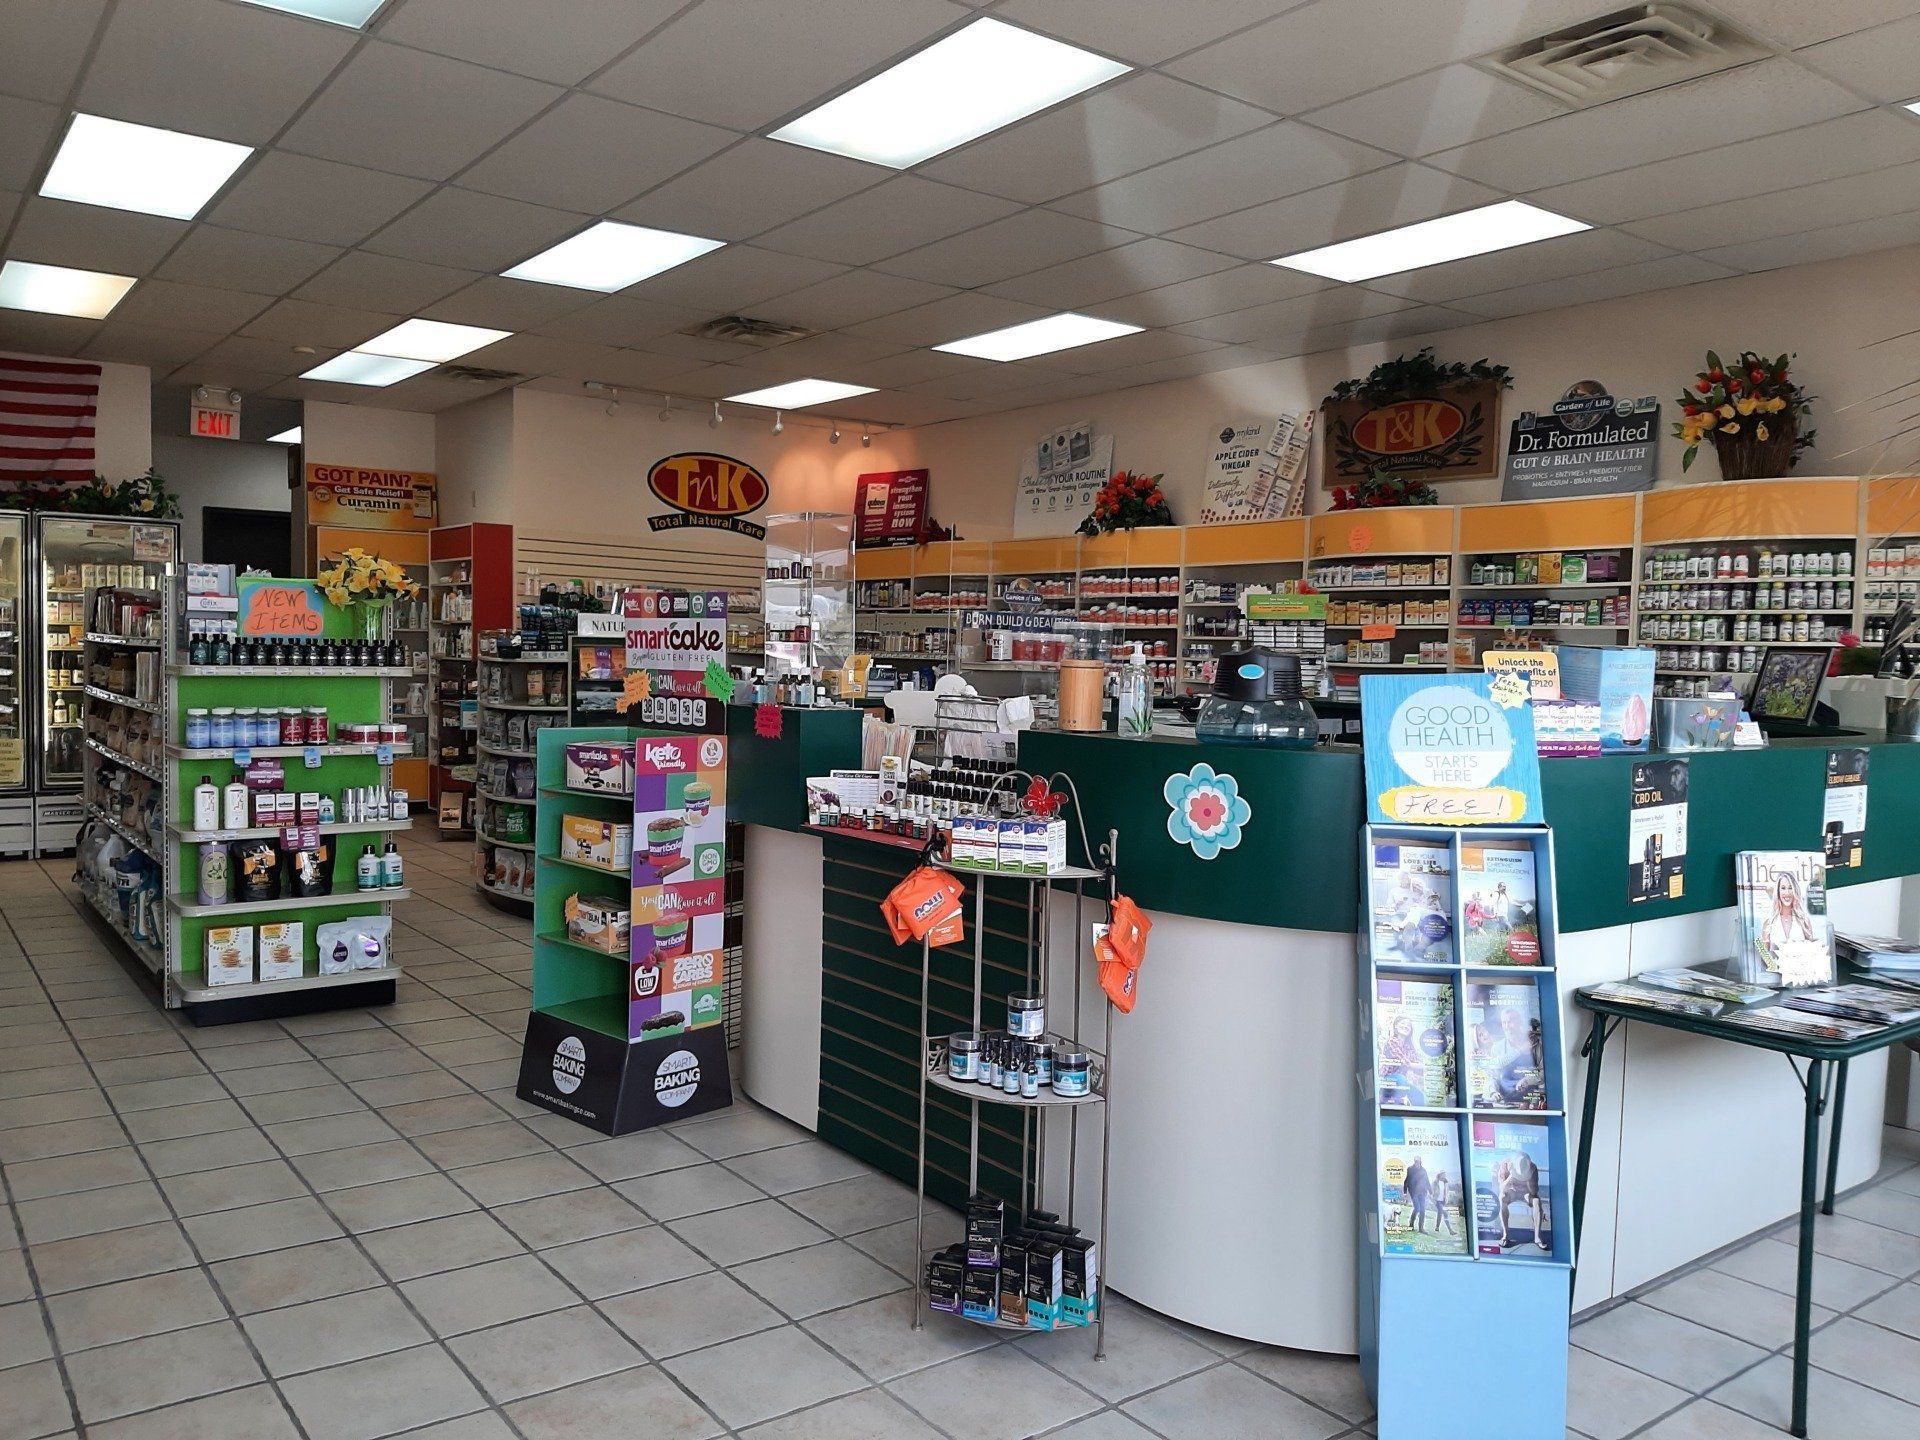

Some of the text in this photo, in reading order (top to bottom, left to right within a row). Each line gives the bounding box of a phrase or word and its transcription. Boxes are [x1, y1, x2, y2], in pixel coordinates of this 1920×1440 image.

[1555, 403, 1584, 412] Garden
[1595, 398, 1611, 407] Life
[197, 410, 234, 436] EXIT
[1367, 402, 1446, 451] T&K
[1517, 421, 1649, 452] Dr. Formulated
[1215, 449, 1260, 461] APPLE CIDER
[1513, 448, 1646, 469] GUT & BRAIN HEALTH
[1221, 460, 1251, 470] VINEGAR
[314, 467, 412, 488] GOT PAIN?
[1054, 469, 1106, 483] YOUR ROUTINE
[1512, 472, 1549, 481] PROBIOTICS
[1555, 469, 1584, 478] ENZYMES
[1532, 475, 1618, 487] MAGNESIUM BRAIN HEALTH
[334, 485, 351, 494] Get
[353, 487, 373, 496] Safe
[337, 495, 401, 510] Curamin
[653, 515, 764, 538] Total Natural Kare
[254, 588, 305, 608] NEW
[996, 616, 1023, 627] BUILD
[626, 621, 724, 652] smartcake
[650, 653, 684, 662] GLUTEN
[688, 654, 711, 662] FREE
[1498, 658, 1543, 667] Unlock the
[1548, 667, 1557, 676] of
[1405, 705, 1490, 726] GOOD
[1404, 726, 1494, 746] HEALTH
[645, 742, 682, 763] keto
[1425, 755, 1478, 768] STARTS
[1433, 769, 1472, 782] HERE
[1635, 791, 1663, 805] CBD OIL
[658, 892, 678, 910] CAN
[674, 953, 714, 972] ZERO
[640, 976, 654, 989] LOW
[560, 1042, 583, 1057] SMART
[552, 1053, 585, 1078] BAKING
[662, 1056, 692, 1071] SMART
[654, 1067, 701, 1090] BAKING
[661, 1086, 694, 1101] COMPANY
